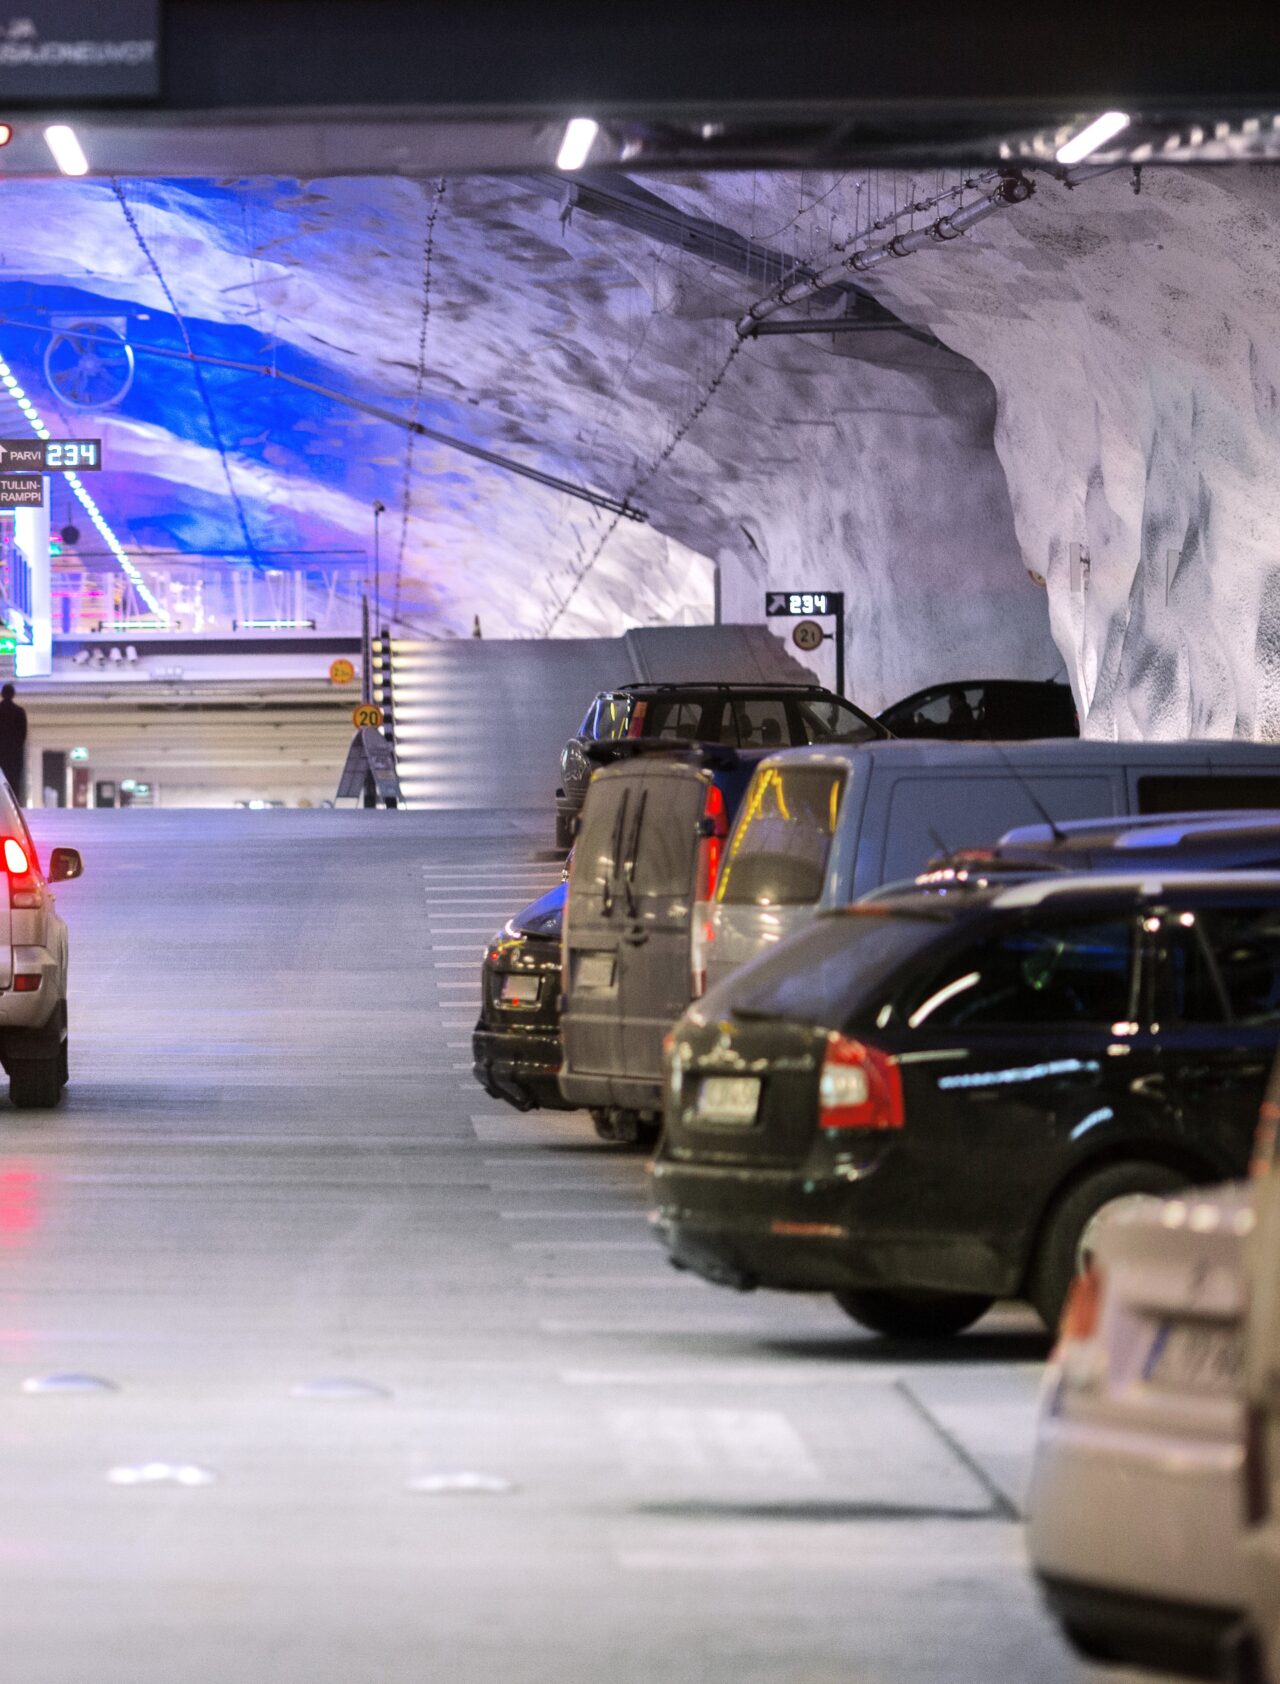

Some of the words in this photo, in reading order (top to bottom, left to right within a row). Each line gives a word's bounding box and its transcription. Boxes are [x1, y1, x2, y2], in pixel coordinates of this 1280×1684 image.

[10, 451, 42, 461] PARVI
[47, 444, 96, 466] 234
[0, 480, 41, 490] TULLIN-
[0, 492, 42, 502] RAMPPI
[789, 595, 826, 614] 234
[359, 710, 379, 727] 20
